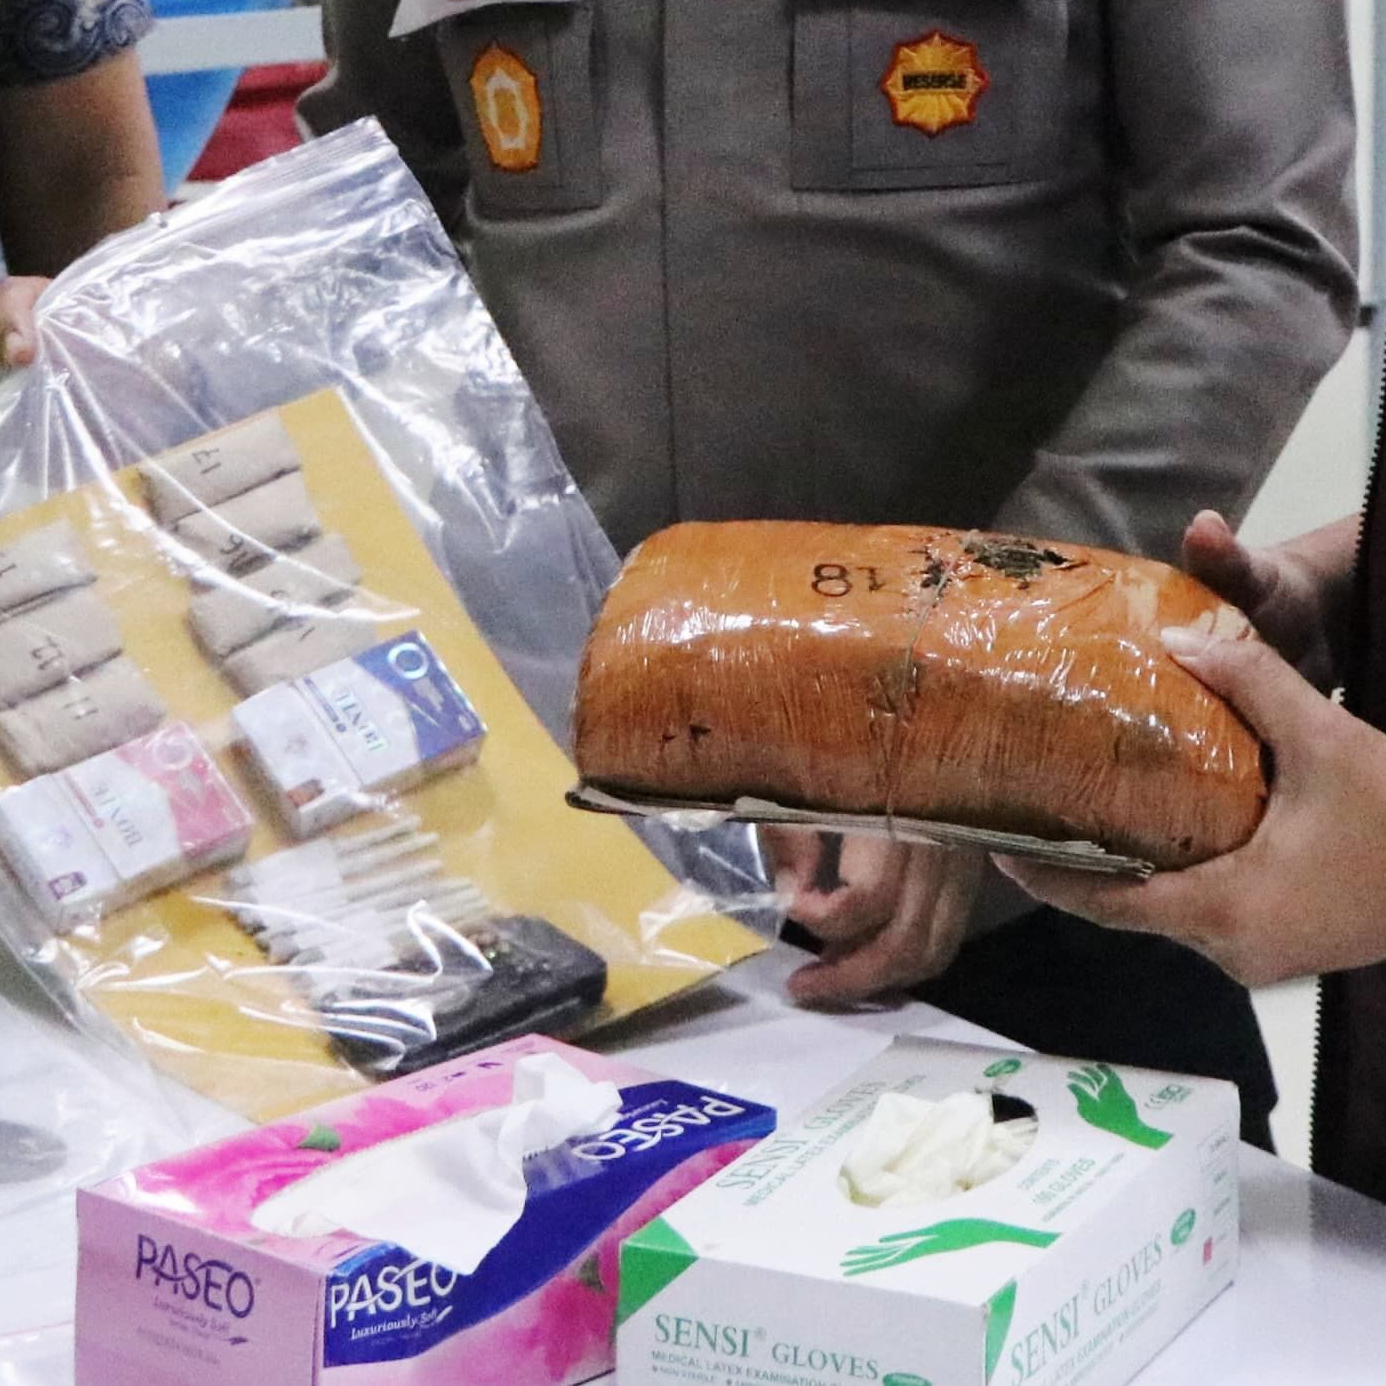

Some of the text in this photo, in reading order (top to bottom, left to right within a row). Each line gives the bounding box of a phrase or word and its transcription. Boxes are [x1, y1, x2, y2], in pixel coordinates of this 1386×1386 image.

[572, 1095, 746, 1162] PASEO
[715, 1132, 809, 1190] SENSI
[135, 1234, 255, 1319] PASEO
[330, 1257, 458, 1329] PASEO
[1011, 1293, 1080, 1386] SENSI
[1093, 1234, 1163, 1316] GLOVES
[351, 1313, 418, 1340] Luxuriously
[654, 1312, 881, 1381] SENSI GLOVES
